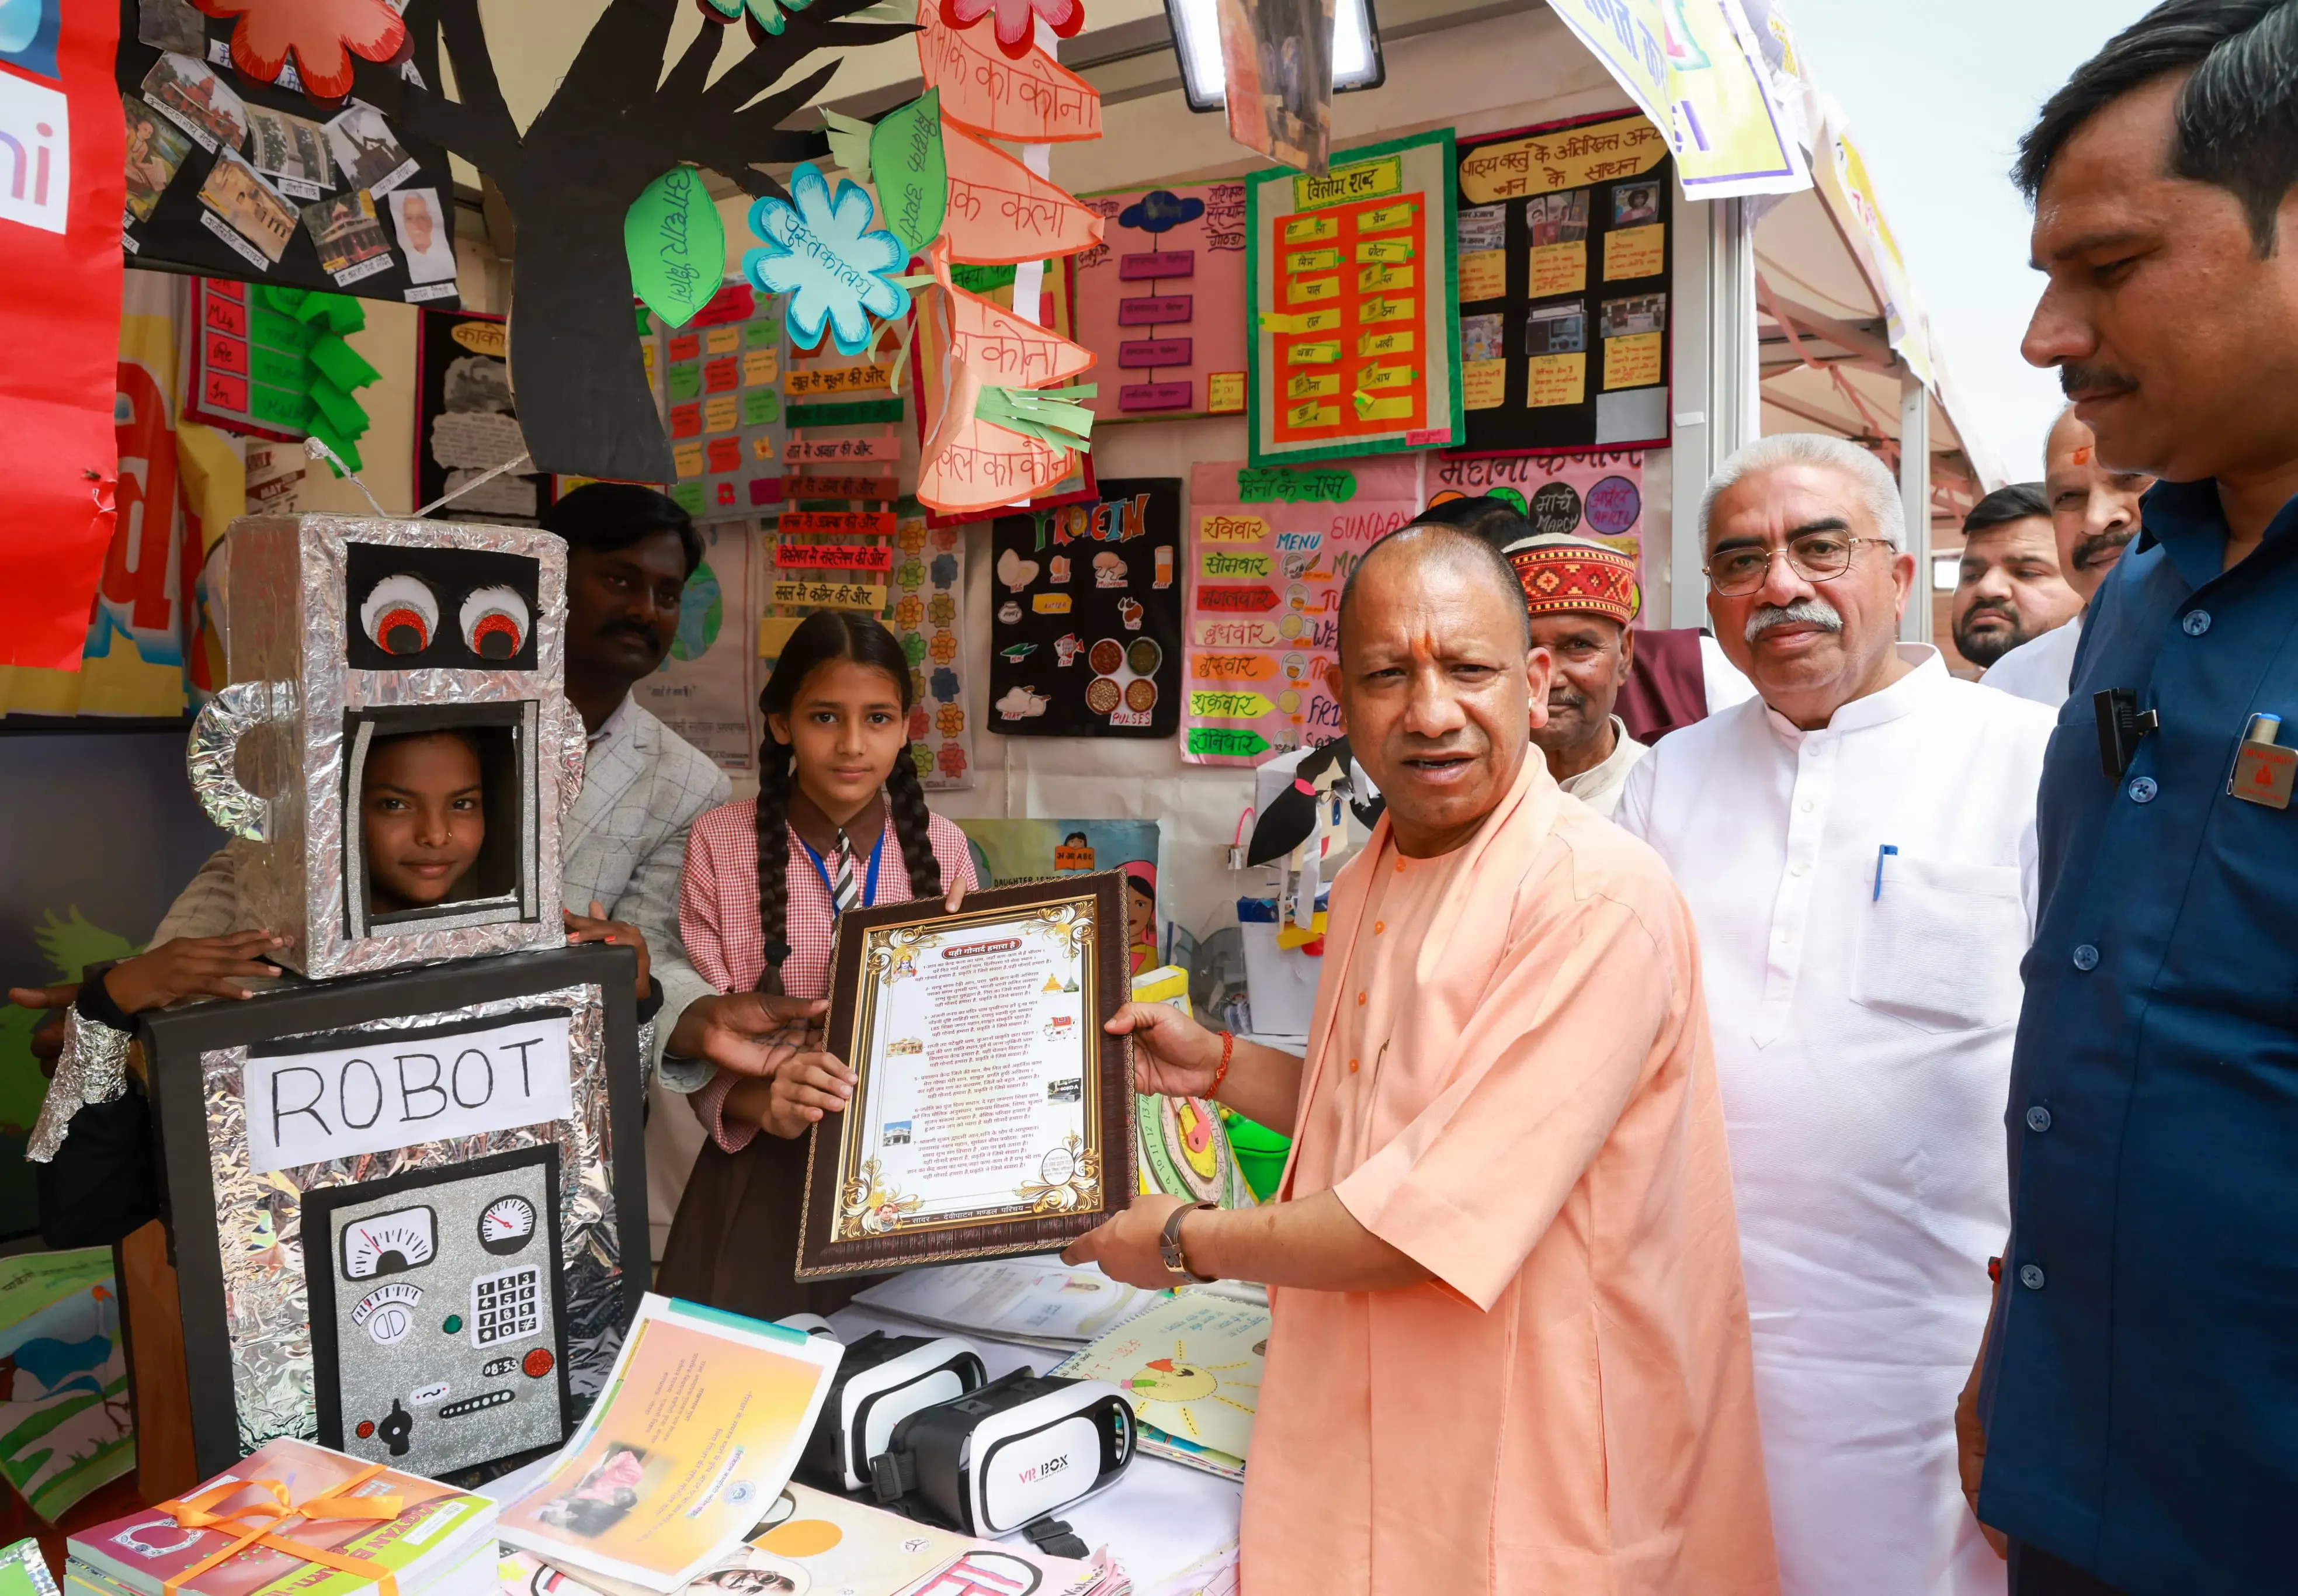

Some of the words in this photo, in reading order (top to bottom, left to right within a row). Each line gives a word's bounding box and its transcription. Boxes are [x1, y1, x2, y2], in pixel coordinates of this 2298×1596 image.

[1543, 167, 1566, 187] के
[1276, 533, 1321, 550] MENU
[1111, 712, 1151, 726] PULSES
[948, 949, 961, 957] यही
[964, 944, 985, 954] गोनार्द
[987, 943, 1008, 951] हमारा
[272, 1038, 544, 1147] ROBOT
[943, 1209, 973, 1220] देवीपाटन
[976, 1208, 997, 1216] मण्डल
[1001, 1203, 1023, 1213] परिचय
[481, 1284, 488, 1294] 1
[502, 1278, 512, 1289] 2
[522, 1274, 530, 1285] 3
[481, 1297, 491, 1308] 4
[503, 1294, 512, 1304] 5
[523, 1288, 530, 1298] 6
[483, 1314, 491, 1326] 7
[502, 1309, 512, 1319] 8
[522, 1304, 529, 1315] 9
[502, 1325, 512, 1335] 0
[484, 1359, 519, 1375] 08:53
[1019, 1467, 1036, 1484] VR
[1041, 1454, 1068, 1476] BOX
[366, 1502, 444, 1550] VIGYAN
